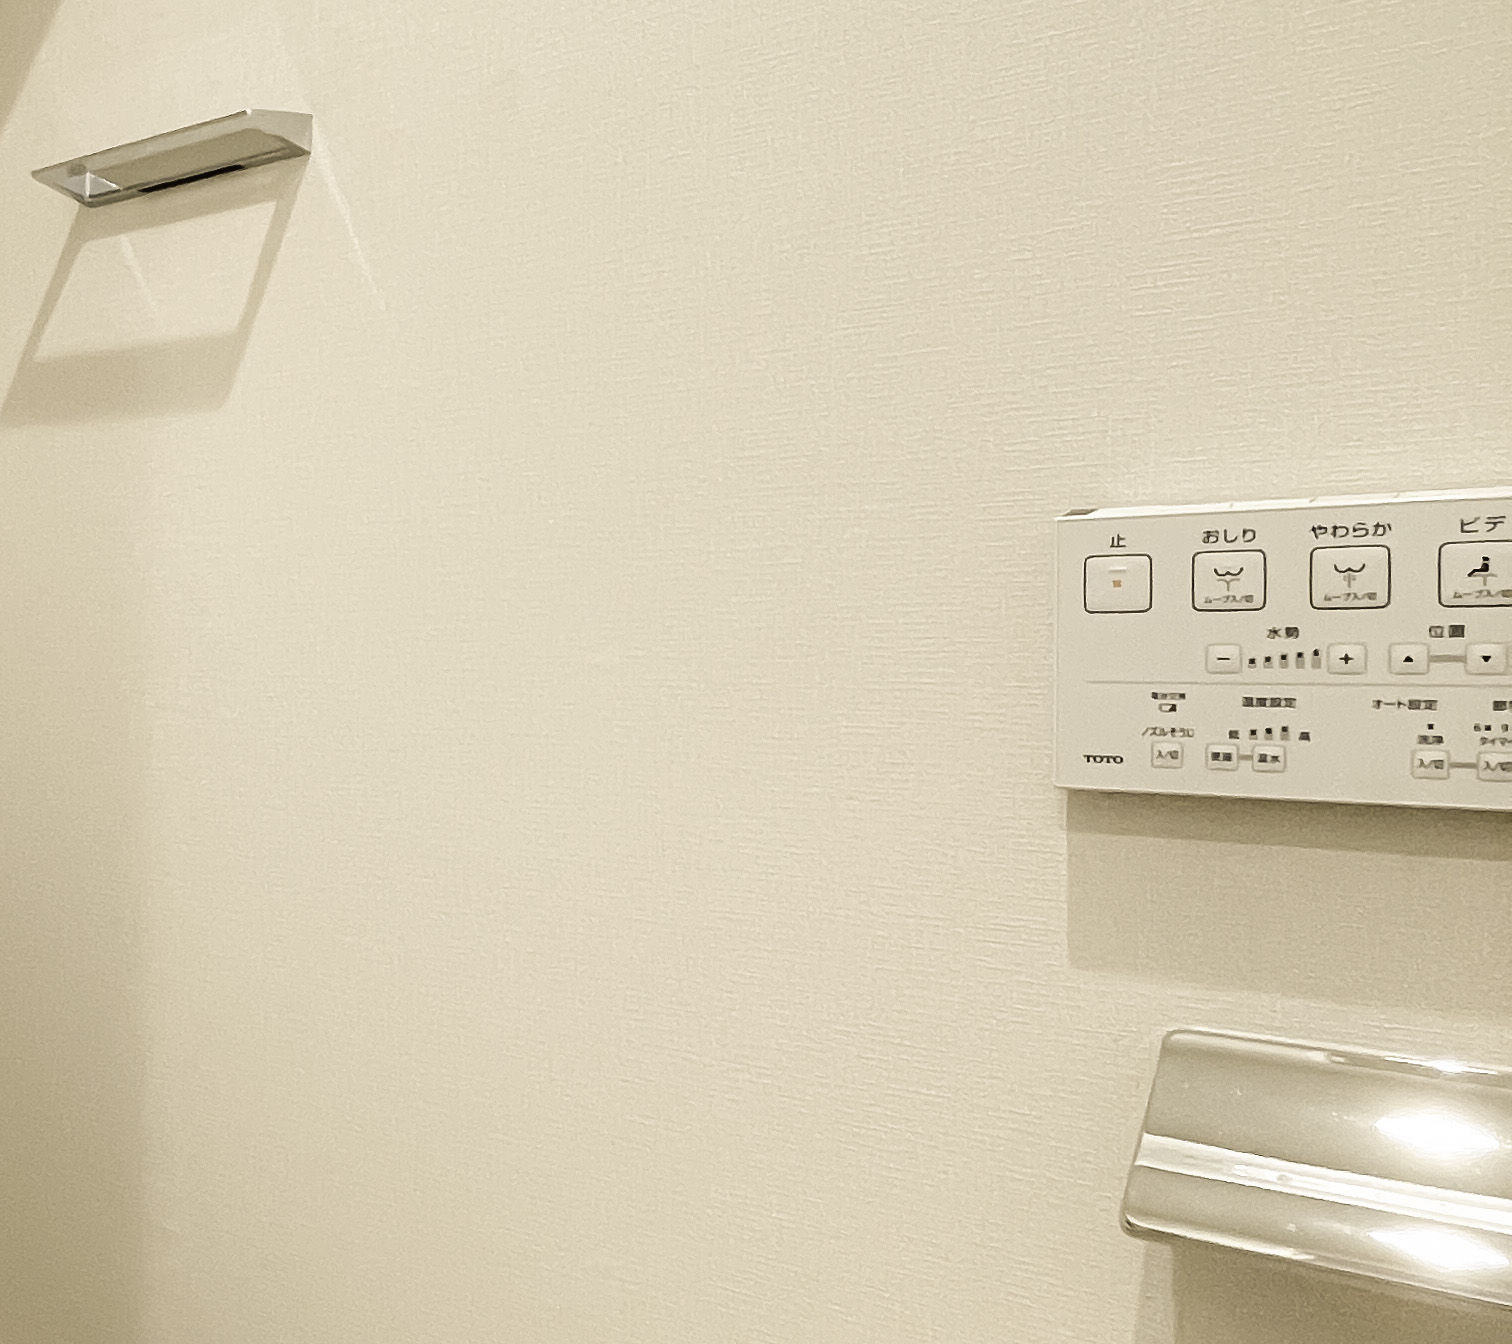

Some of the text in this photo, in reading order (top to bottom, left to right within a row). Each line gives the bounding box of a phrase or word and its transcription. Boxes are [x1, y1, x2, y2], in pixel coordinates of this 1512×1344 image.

[1201, 528, 1257, 544] おしり
[1309, 522, 1392, 540] やわらか
[1109, 533, 1127, 548] 止
[1082, 754, 1125, 765] TOTO
